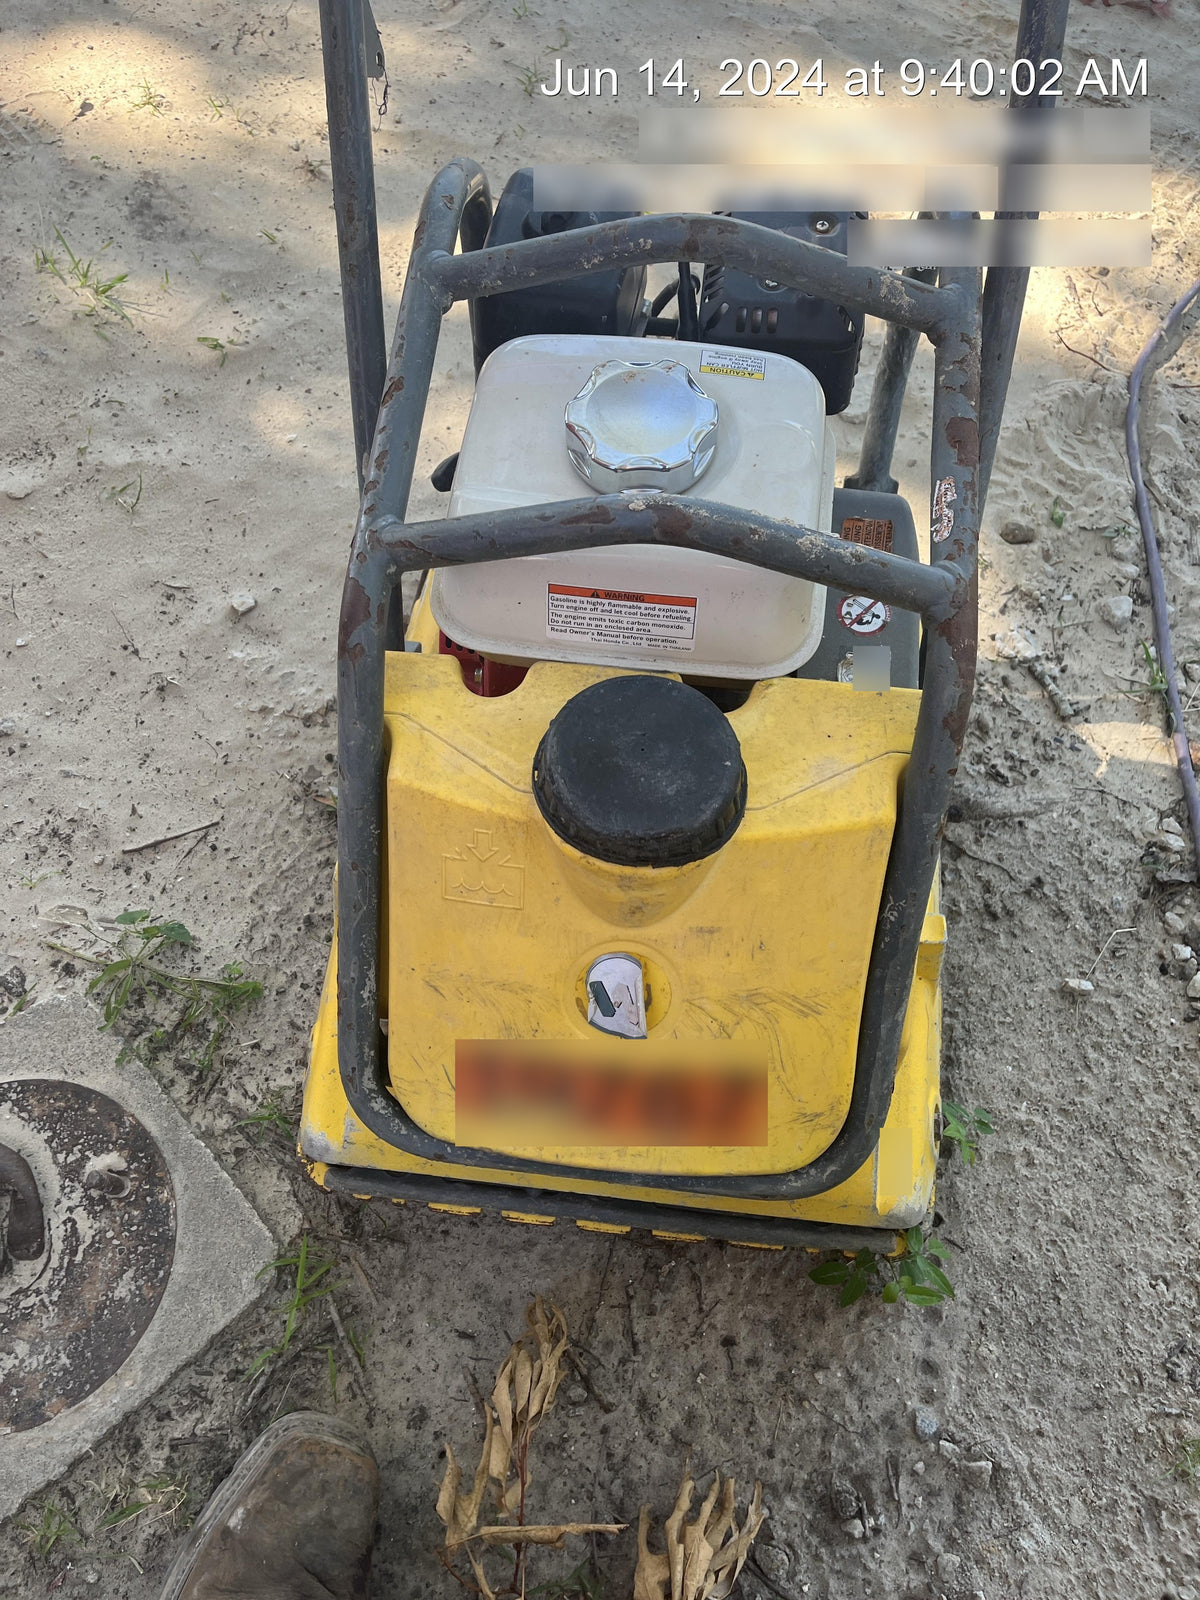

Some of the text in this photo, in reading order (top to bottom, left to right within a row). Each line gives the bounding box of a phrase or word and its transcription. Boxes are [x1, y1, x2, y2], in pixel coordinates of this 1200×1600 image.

[710, 368, 745, 376] CAUTION
[604, 592, 645, 602] WARNING
[551, 596, 577, 604] Gasoline
[587, 598, 605, 607] highly
[608, 602, 641, 611] flammable
[658, 607, 690, 615] explosive.
[565, 613, 586, 621] engine
[652, 622, 685, 630] monoxide.
[663, 613, 692, 622] refueling.
[569, 628, 595, 636] Owner's
[622, 633, 643, 641] before
[646, 636, 678, 644] operation.
